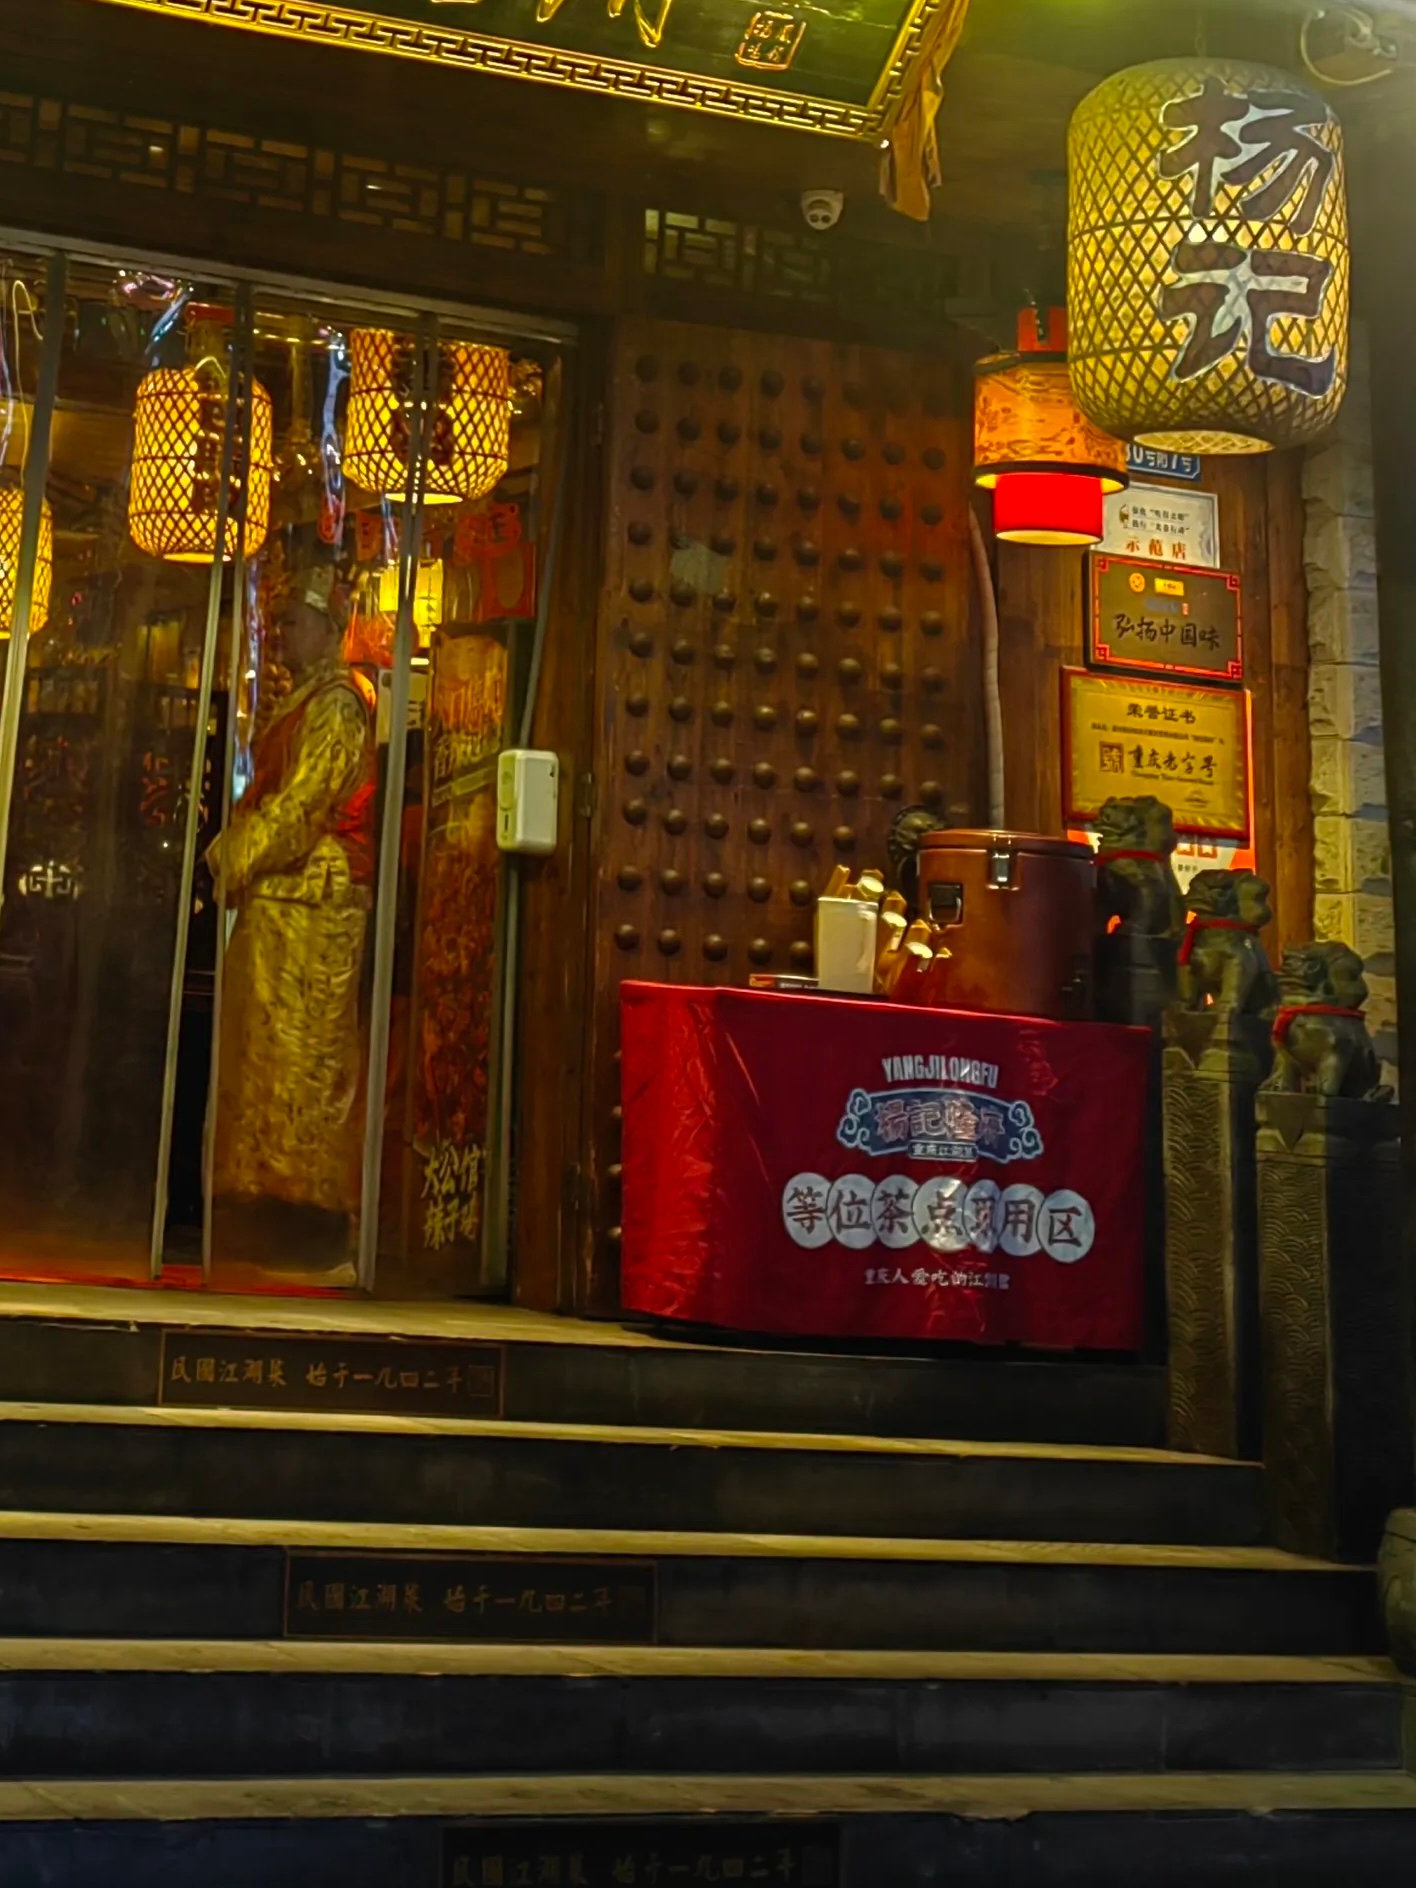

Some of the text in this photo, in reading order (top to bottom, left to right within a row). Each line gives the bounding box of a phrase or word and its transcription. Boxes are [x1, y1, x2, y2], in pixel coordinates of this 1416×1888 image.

[1127, 702, 1197, 725] 荣誉证书
[881, 1054, 1000, 1089] YANGJILONGFU
